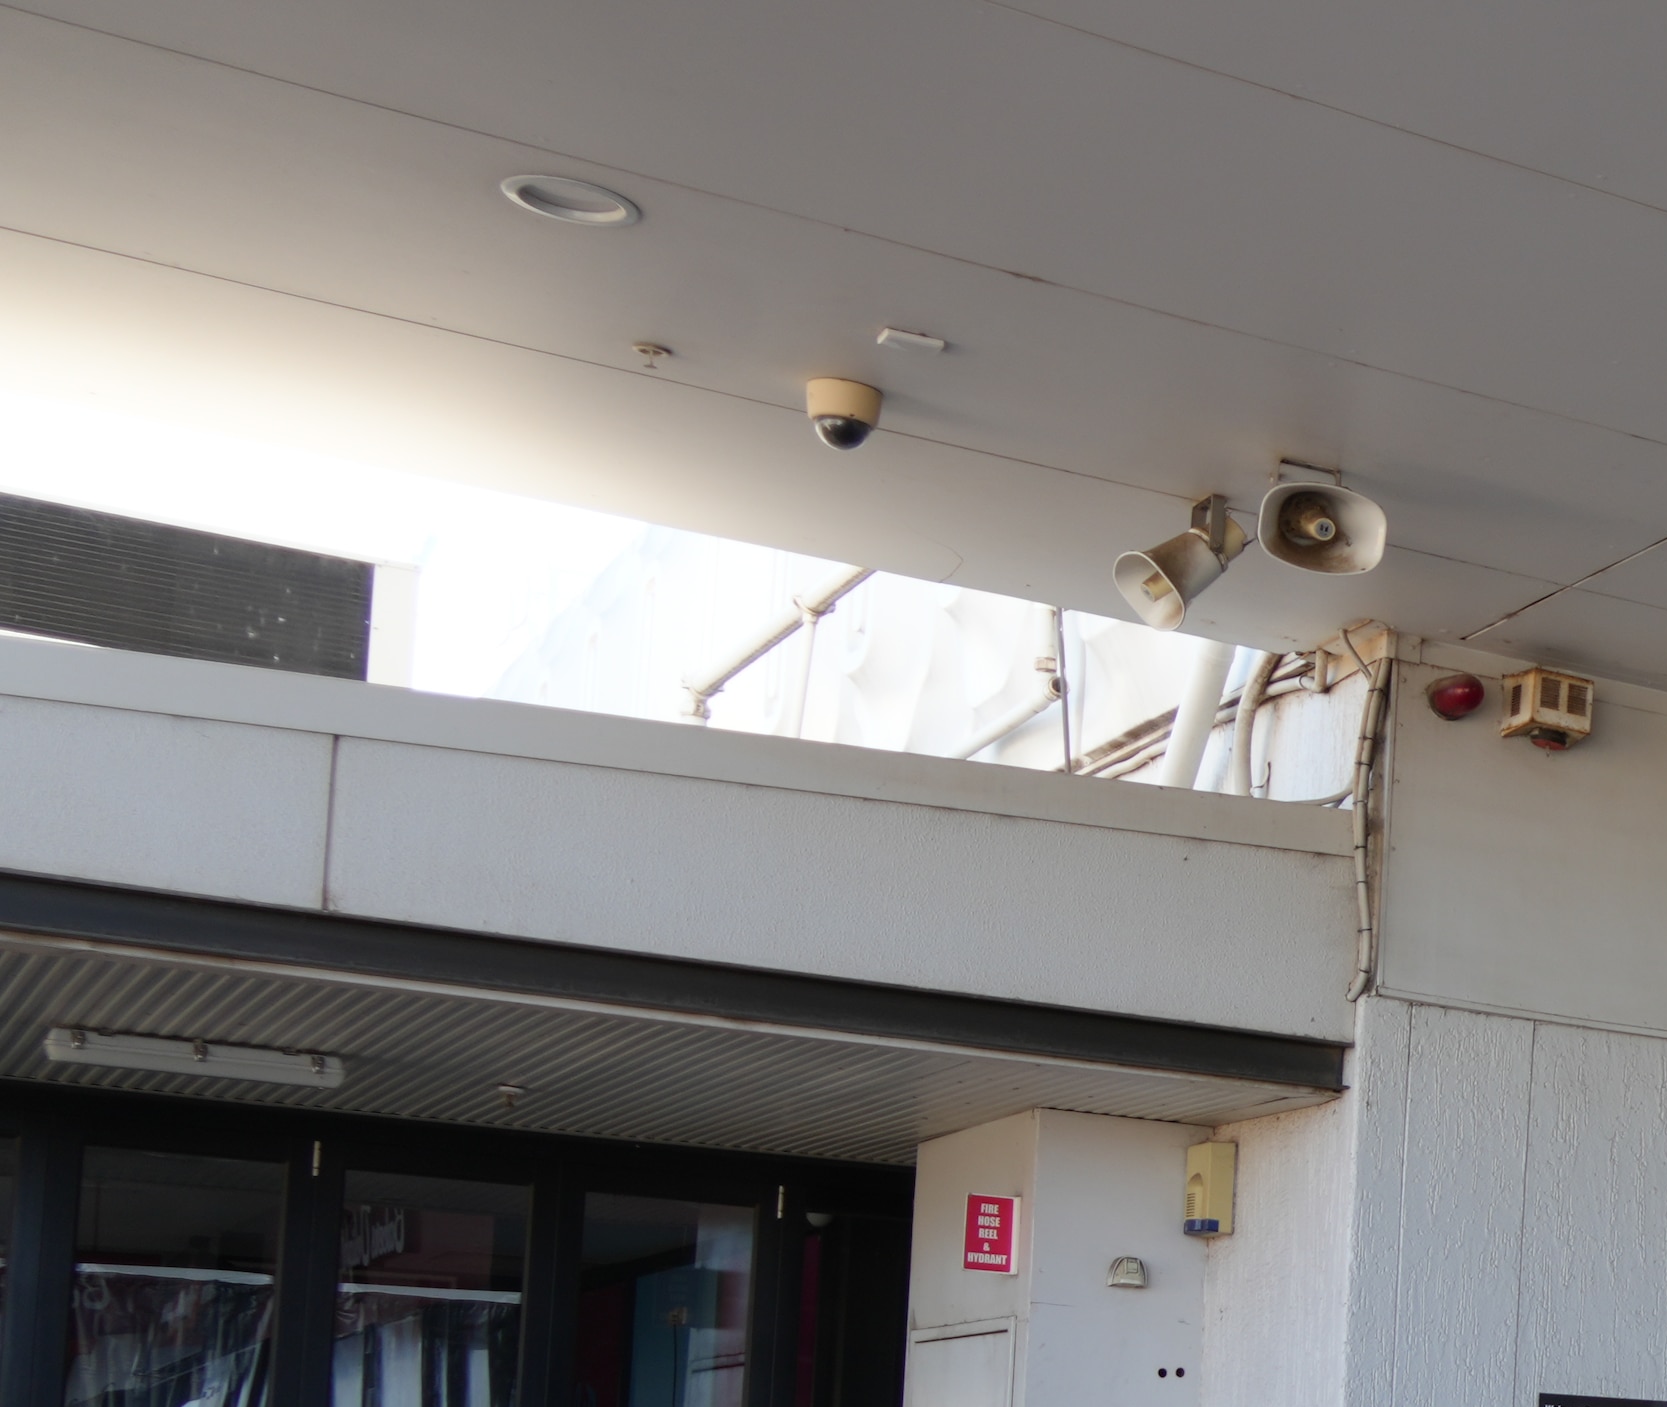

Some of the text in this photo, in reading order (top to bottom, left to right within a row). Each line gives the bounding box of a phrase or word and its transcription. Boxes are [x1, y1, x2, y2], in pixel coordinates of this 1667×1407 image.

[980, 1203, 999, 1215] FIRE
[977, 1215, 1001, 1228] HOSE
[978, 1227, 998, 1240] REEL
[983, 1242, 990, 1251] &
[967, 1252, 1008, 1265] HYDRANT
